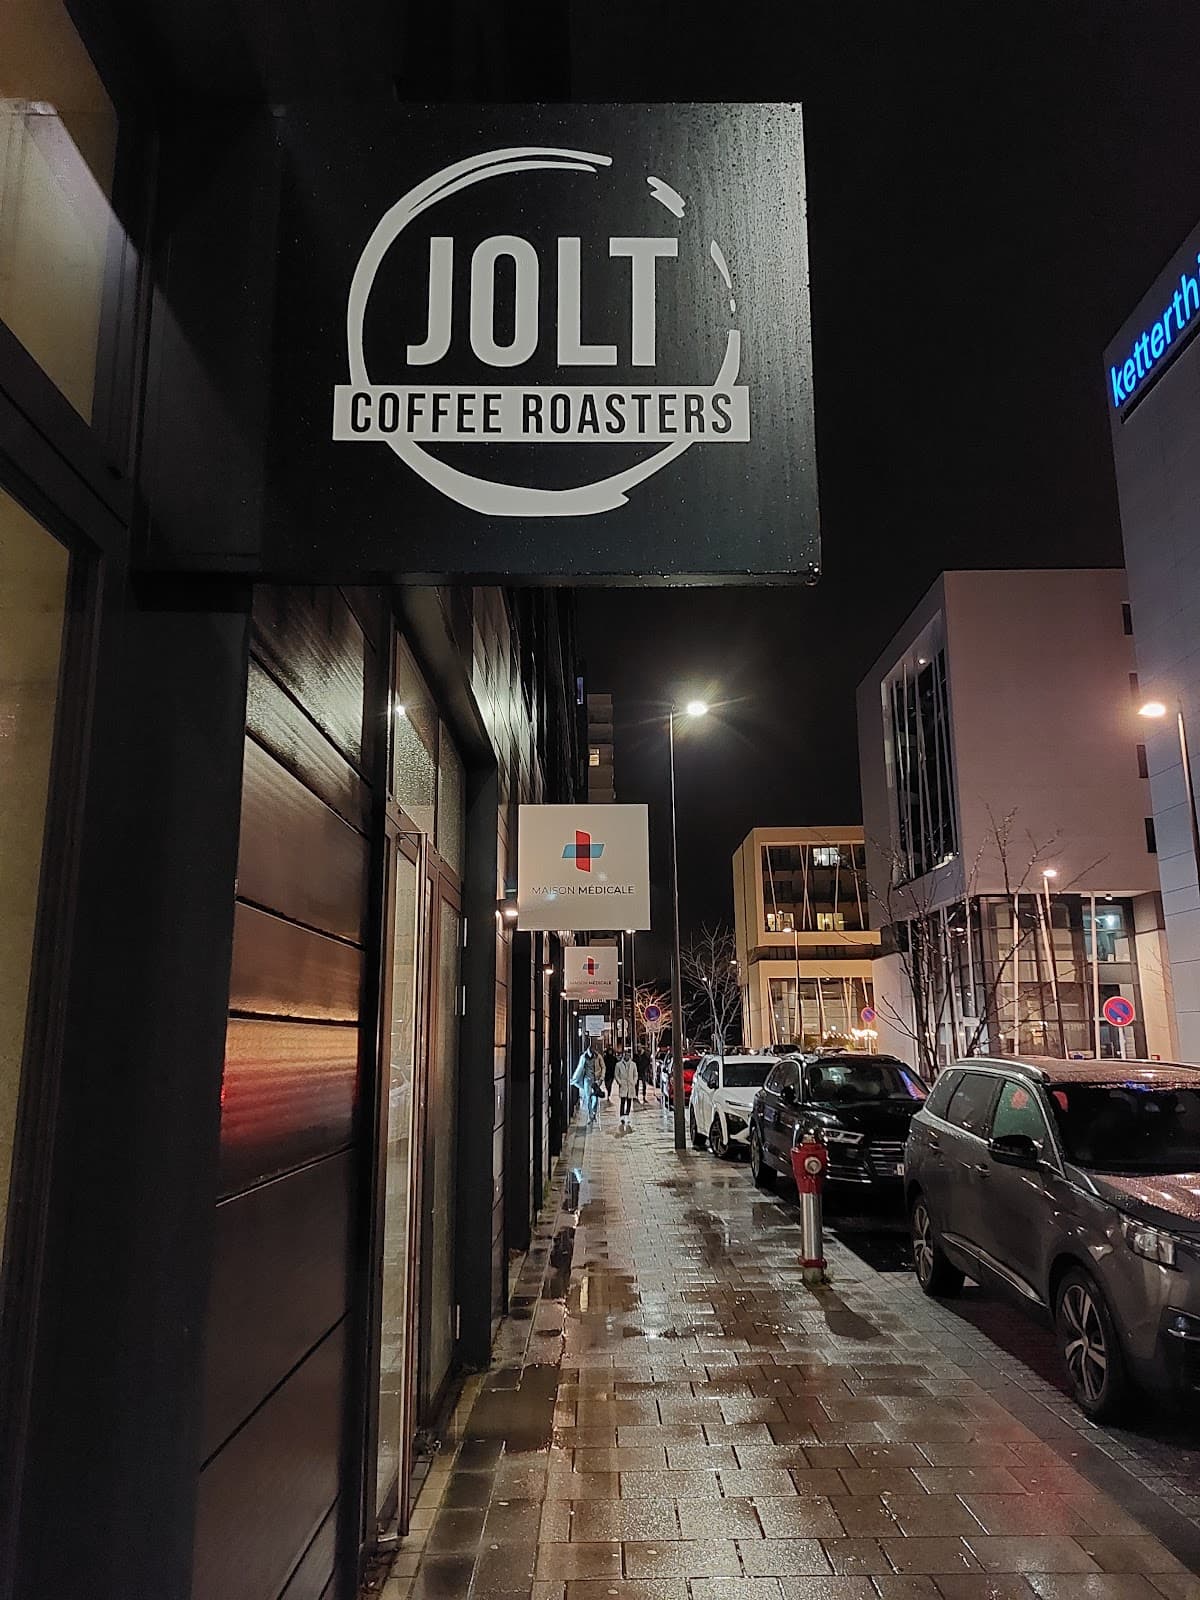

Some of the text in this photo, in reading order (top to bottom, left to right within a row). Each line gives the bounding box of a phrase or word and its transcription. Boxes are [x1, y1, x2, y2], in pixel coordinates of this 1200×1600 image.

[406, 235, 678, 367] JOLT
[350, 392, 733, 434] COFFEE ROASTERS
[532, 884, 635, 895] MAISON MÉDICALE
